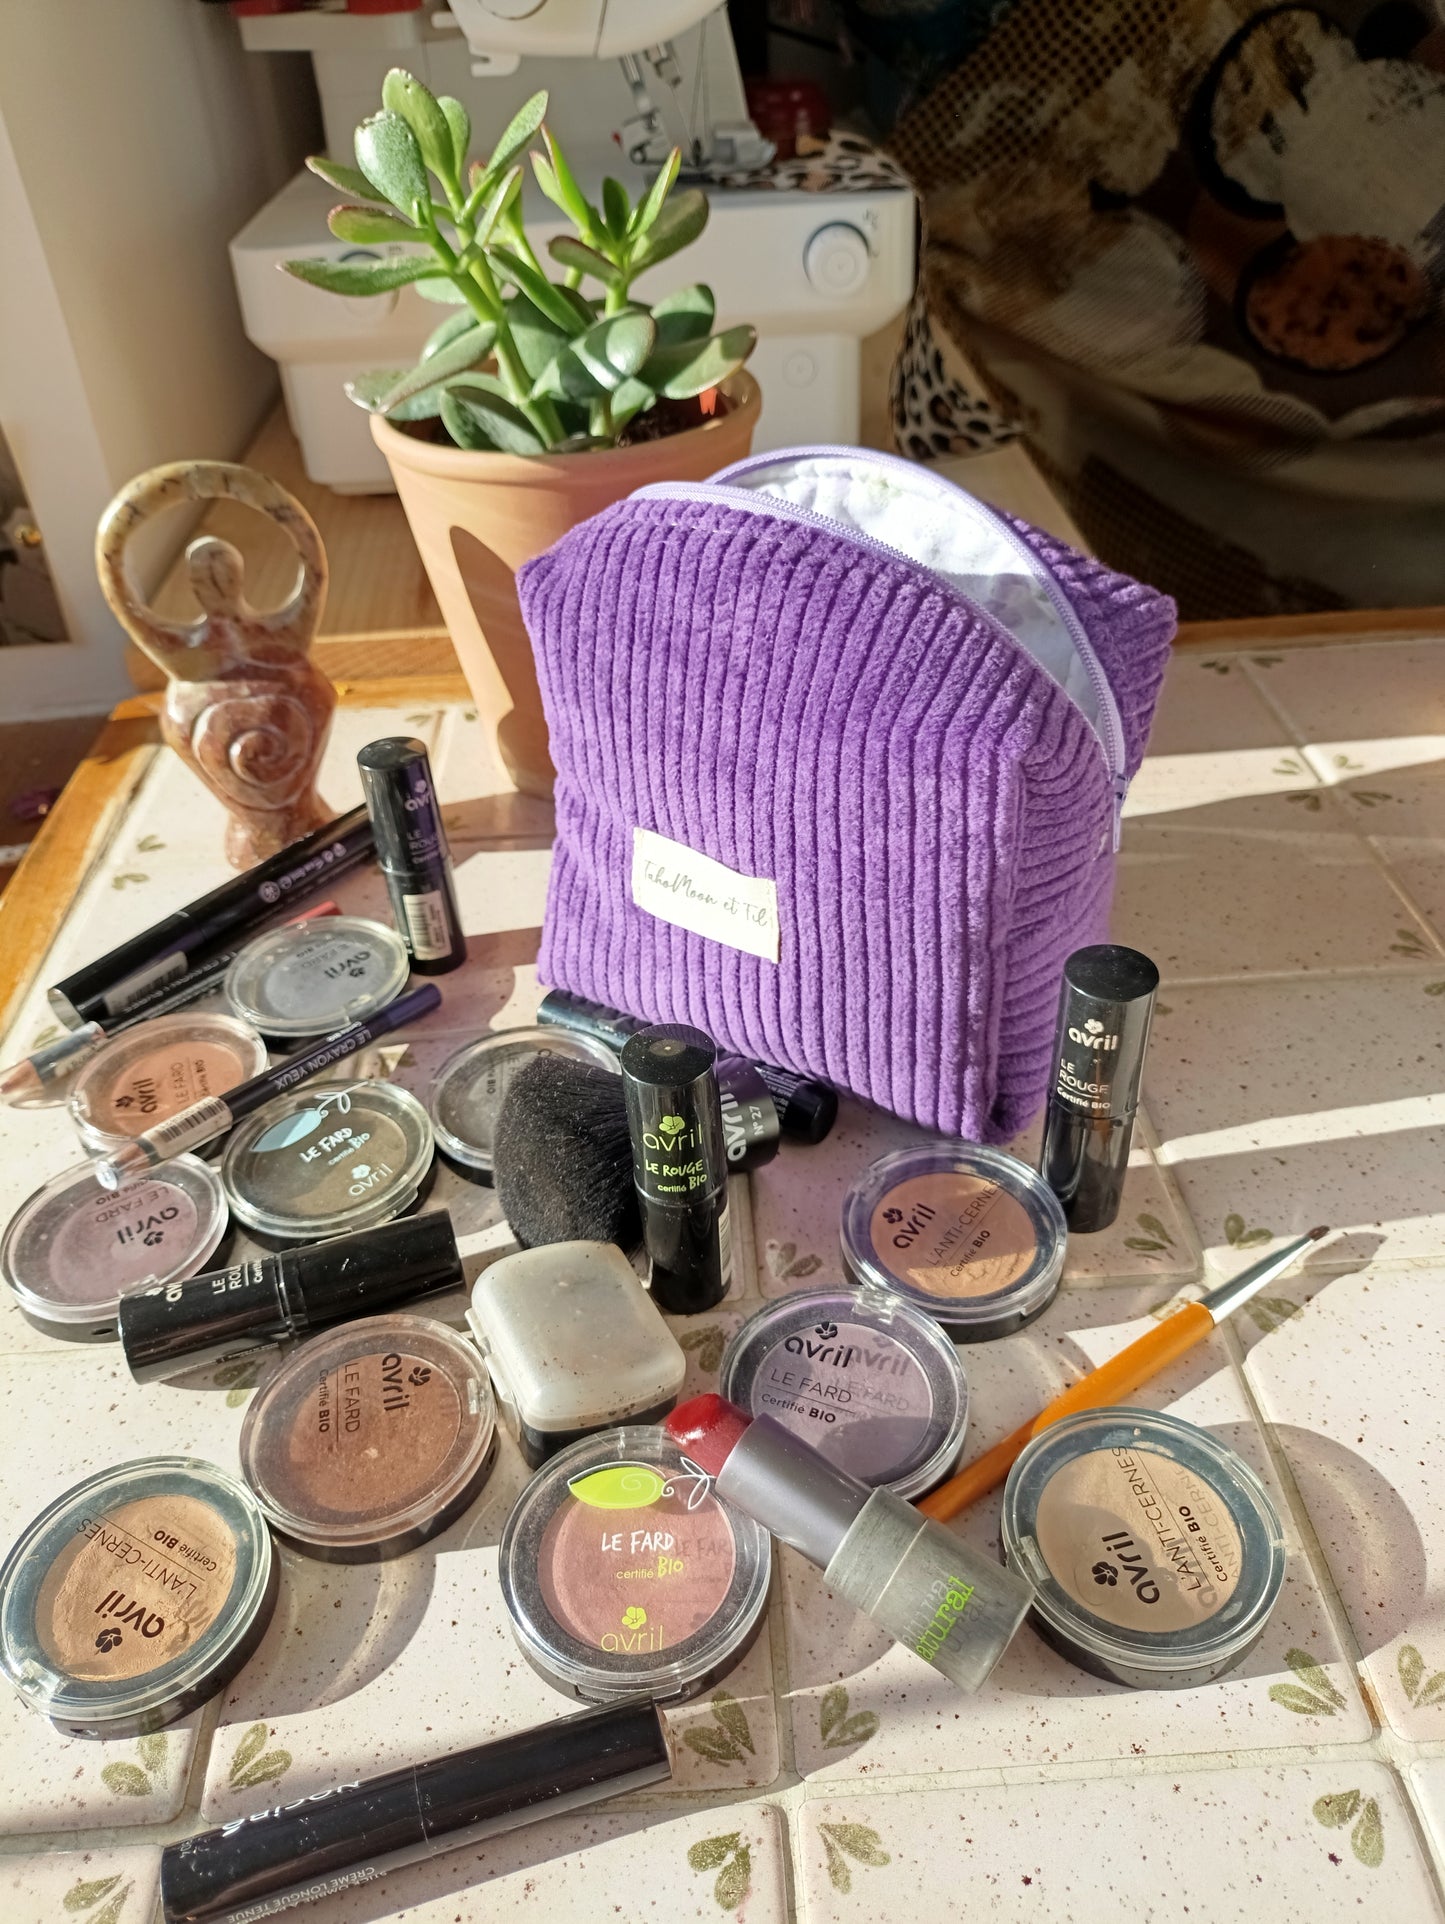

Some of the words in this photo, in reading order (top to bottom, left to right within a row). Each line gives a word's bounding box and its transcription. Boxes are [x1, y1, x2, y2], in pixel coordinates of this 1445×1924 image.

[723, 897, 741, 914] et
[324, 950, 371, 979] avril
[357, 1029, 372, 1045] LE
[1068, 1026, 1119, 1051] avril
[309, 1038, 357, 1071] CRAYON
[1060, 1058, 1075, 1075] LE
[274, 1066, 308, 1090] YEUX
[1059, 1068, 1111, 1095] ROUGE
[133, 1077, 158, 1113] avril
[1056, 1086, 1089, 1109] Certifié
[1091, 1100, 1112, 1110] BIO
[642, 1124, 703, 1152] avril
[720, 1093, 747, 1161] avril
[300, 1146, 322, 1163] LE
[318, 1127, 353, 1152] FARD
[348, 1163, 393, 1196] avril
[645, 1159, 659, 1175] LE
[663, 1159, 704, 1177] ROUGE
[96, 1192, 120, 1205] BIO
[146, 1185, 169, 1202] LE
[96, 1199, 144, 1223] FARD
[117, 1206, 179, 1245] avril
[892, 1202, 937, 1249] avril
[949, 1247, 977, 1279] Certifié
[972, 1229, 992, 1249] BIO
[212, 1278, 226, 1295] LE
[228, 1264, 243, 1290] ROU
[784, 1336, 853, 1369] avril
[344, 1362, 361, 1385] LE
[381, 1352, 410, 1413] avril
[770, 1368, 796, 1386] LE
[799, 1377, 852, 1405] FARD
[318, 1368, 330, 1408] Certifié
[318, 1409, 331, 1433] BIO
[345, 1389, 361, 1433] FARD
[761, 1393, 805, 1415] Certifié
[808, 1408, 837, 1425] BIO
[1111, 1445, 1202, 1591] L'ANTI-CERNES
[1178, 1505, 1201, 1533] BIO
[153, 1529, 179, 1550] BIO
[601, 1532, 623, 1552] LE
[630, 1530, 674, 1554] FARD
[76, 1518, 198, 1600] L'ANTI-CERNES
[179, 1543, 217, 1572] Certifié
[1102, 1530, 1160, 1604] avril
[1198, 1536, 1228, 1583] Certifié
[616, 1567, 654, 1580] certifié
[94, 1590, 166, 1639] avril
[600, 1625, 665, 1652] avril
[332, 1867, 375, 1887] CRÈME
[273, 1882, 328, 1906] LONGUE
[226, 1903, 270, 1923] TENUE
